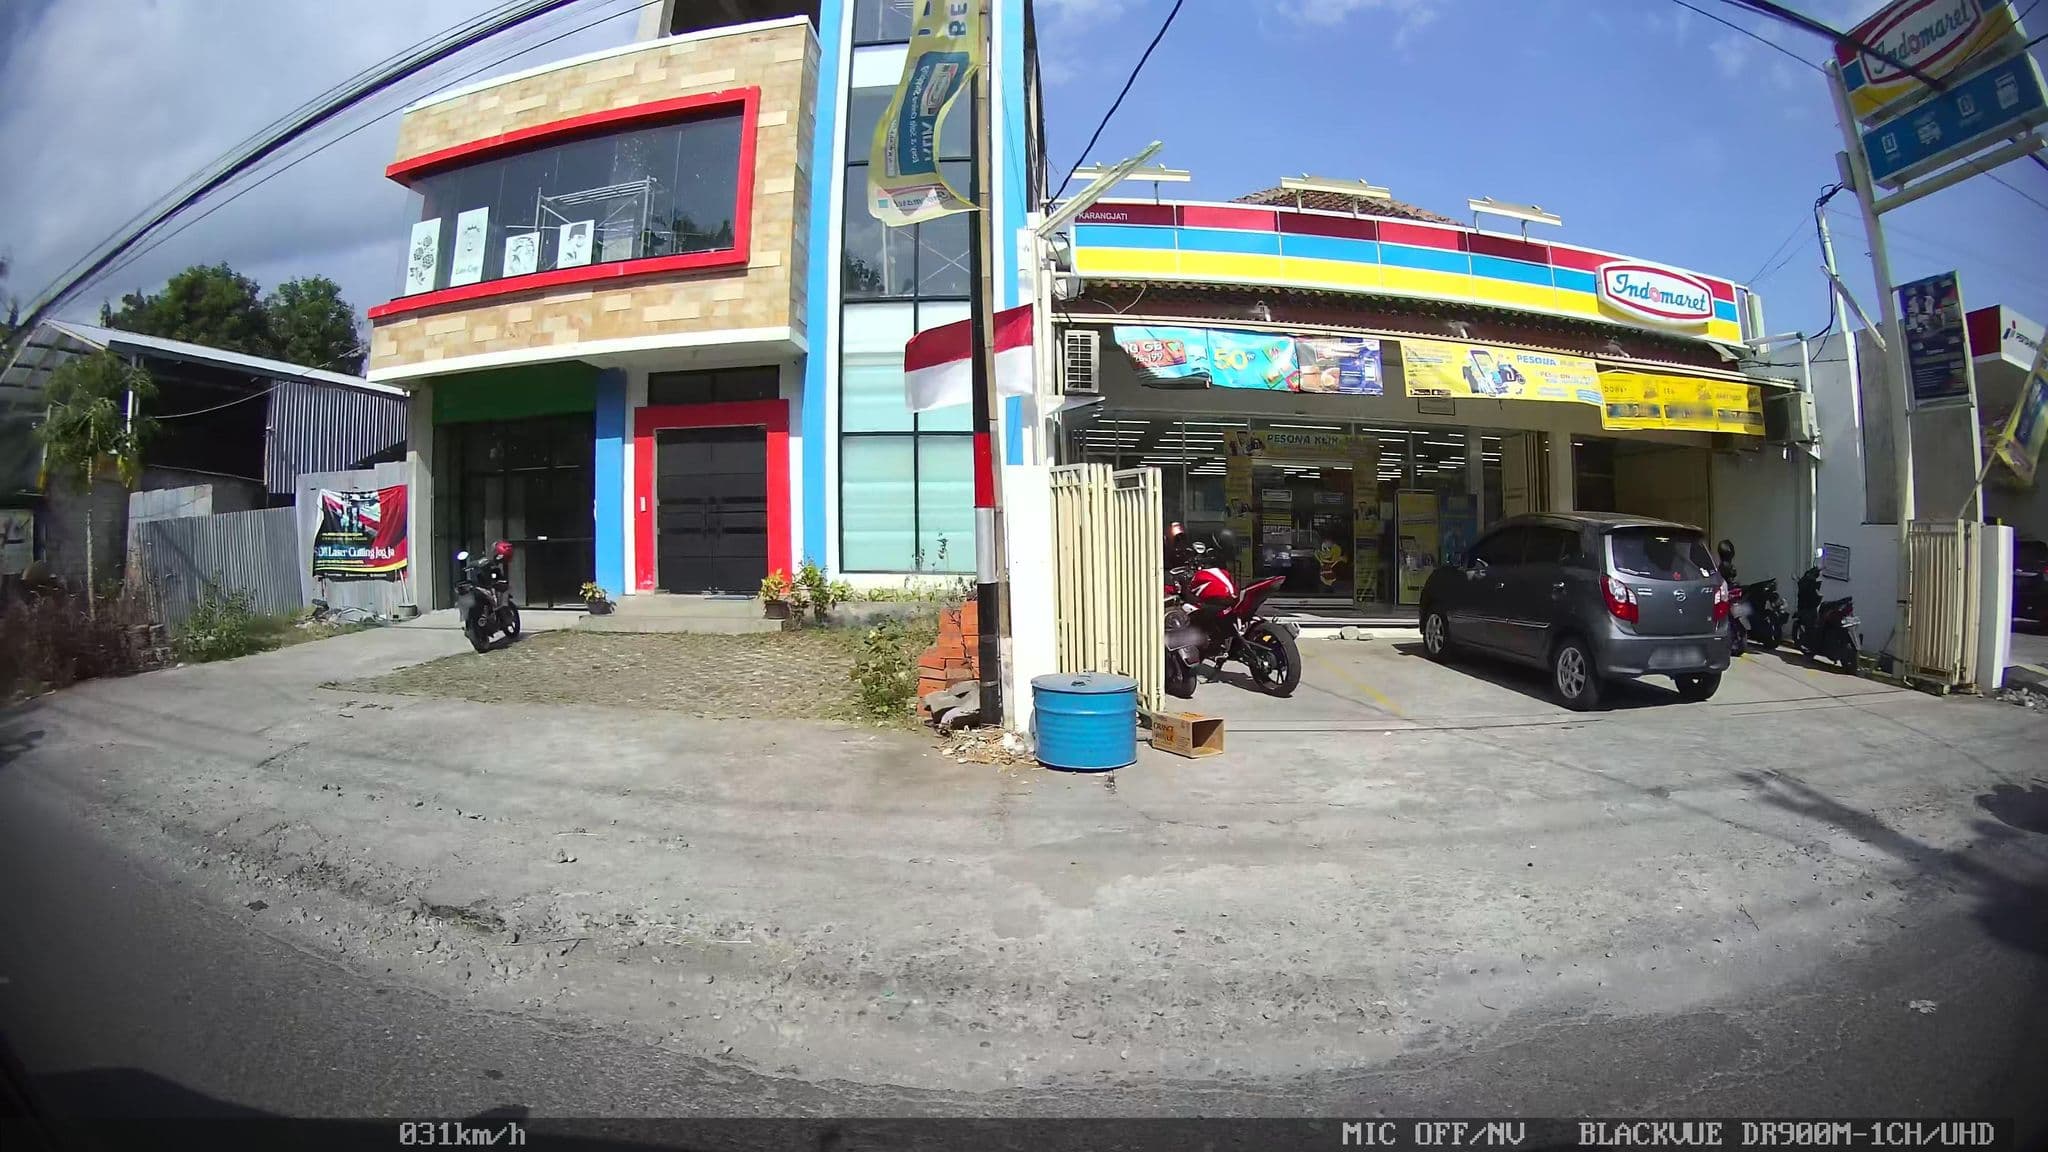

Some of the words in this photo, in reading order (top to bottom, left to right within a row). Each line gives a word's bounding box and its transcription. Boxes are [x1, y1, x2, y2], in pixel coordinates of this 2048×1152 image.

[1078, 211, 1128, 221] KARANGJATI
[1612, 273, 1707, 312] Indomaret
[1267, 434, 1310, 444] PESONA
